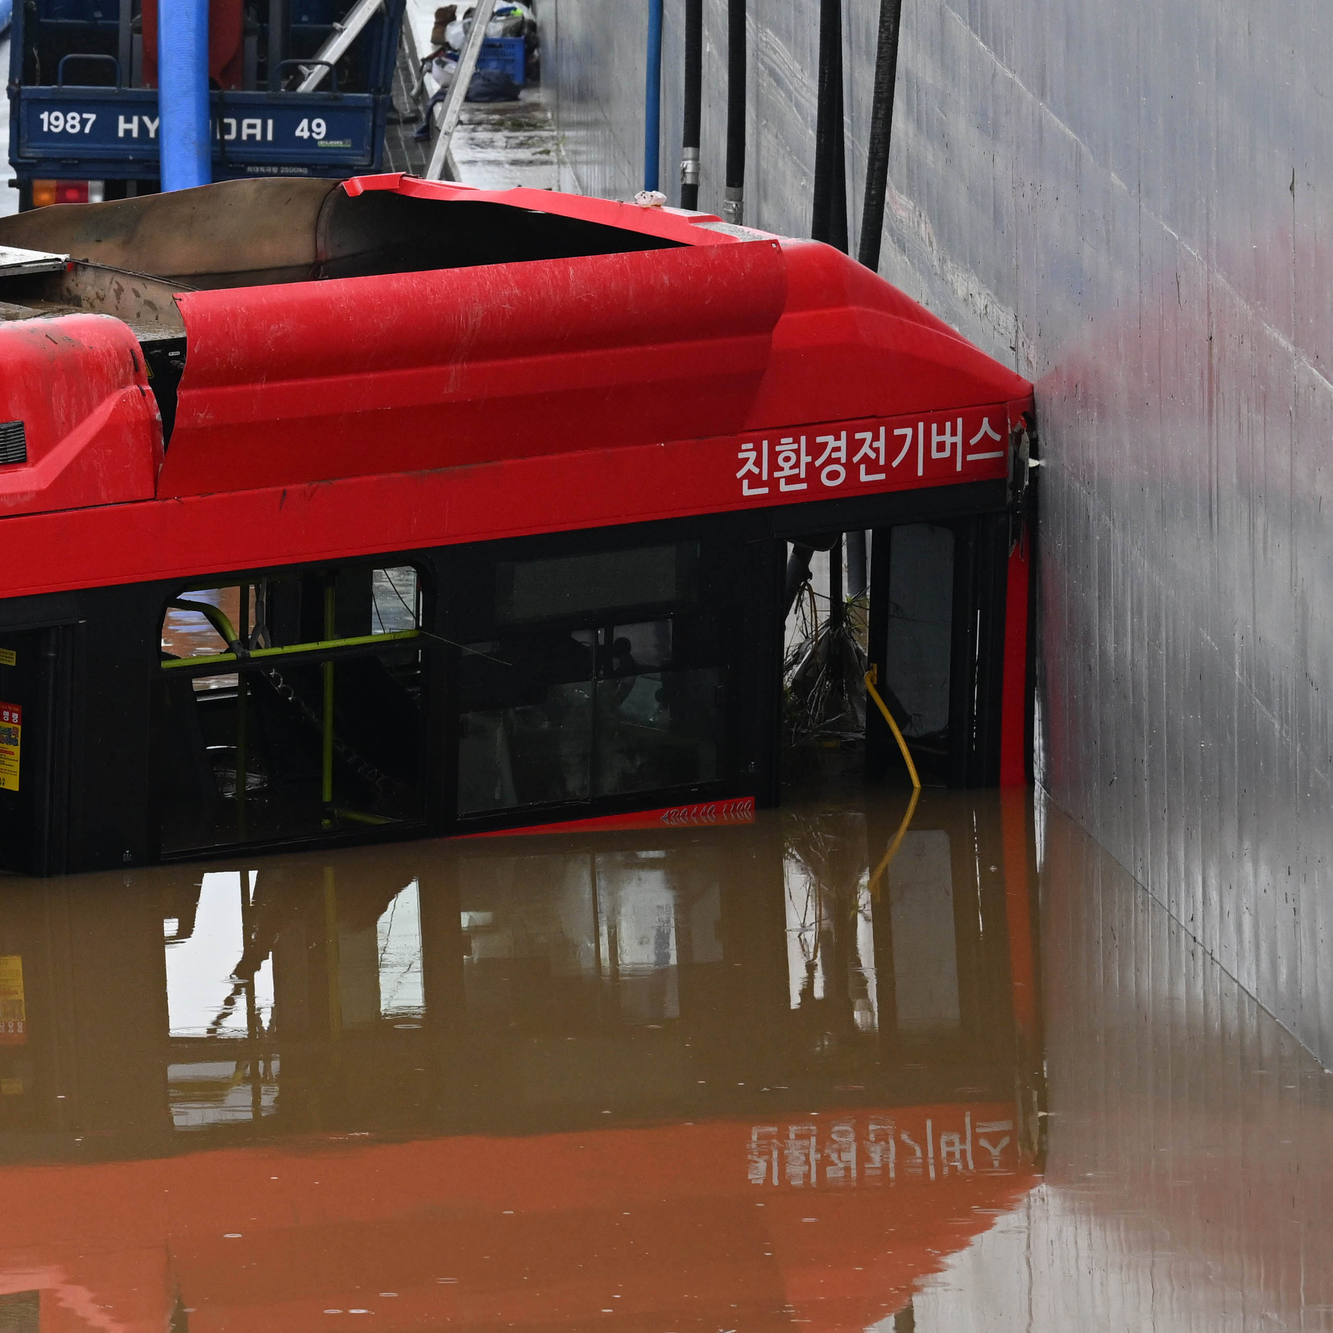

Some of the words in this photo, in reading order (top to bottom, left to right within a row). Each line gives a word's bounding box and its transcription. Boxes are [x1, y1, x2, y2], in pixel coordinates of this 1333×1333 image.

[39, 111, 97, 134] 1987
[294, 117, 327, 140] 49
[279, 166, 309, 175] 2500kg
[735, 416, 1005, 497] 친환경전기버스
